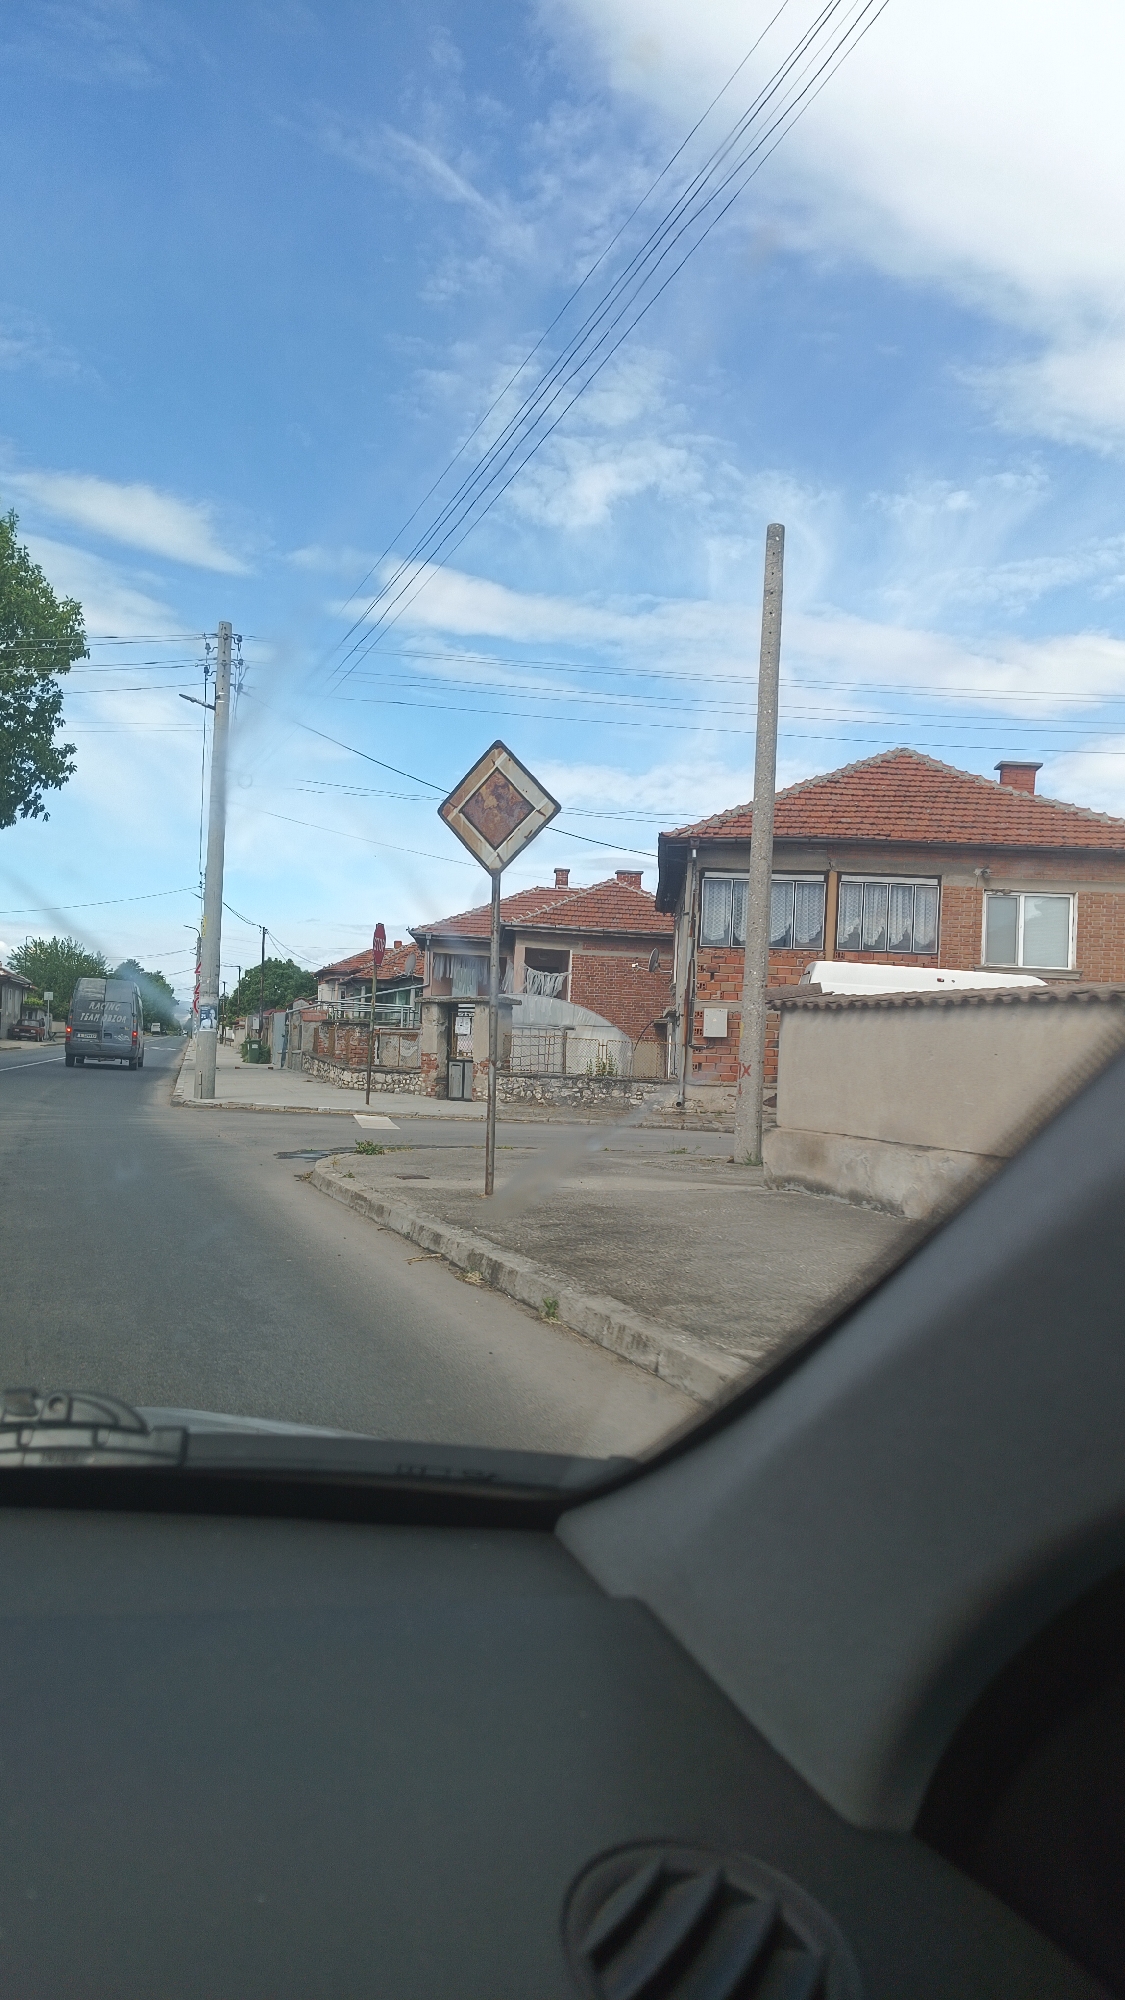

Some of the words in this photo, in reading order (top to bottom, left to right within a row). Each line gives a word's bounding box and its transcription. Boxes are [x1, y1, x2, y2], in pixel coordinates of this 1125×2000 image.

[374, 937, 385, 952] STOP
[88, 1001, 121, 1011] RACING
[80, 1012, 100, 1022] TEAM
